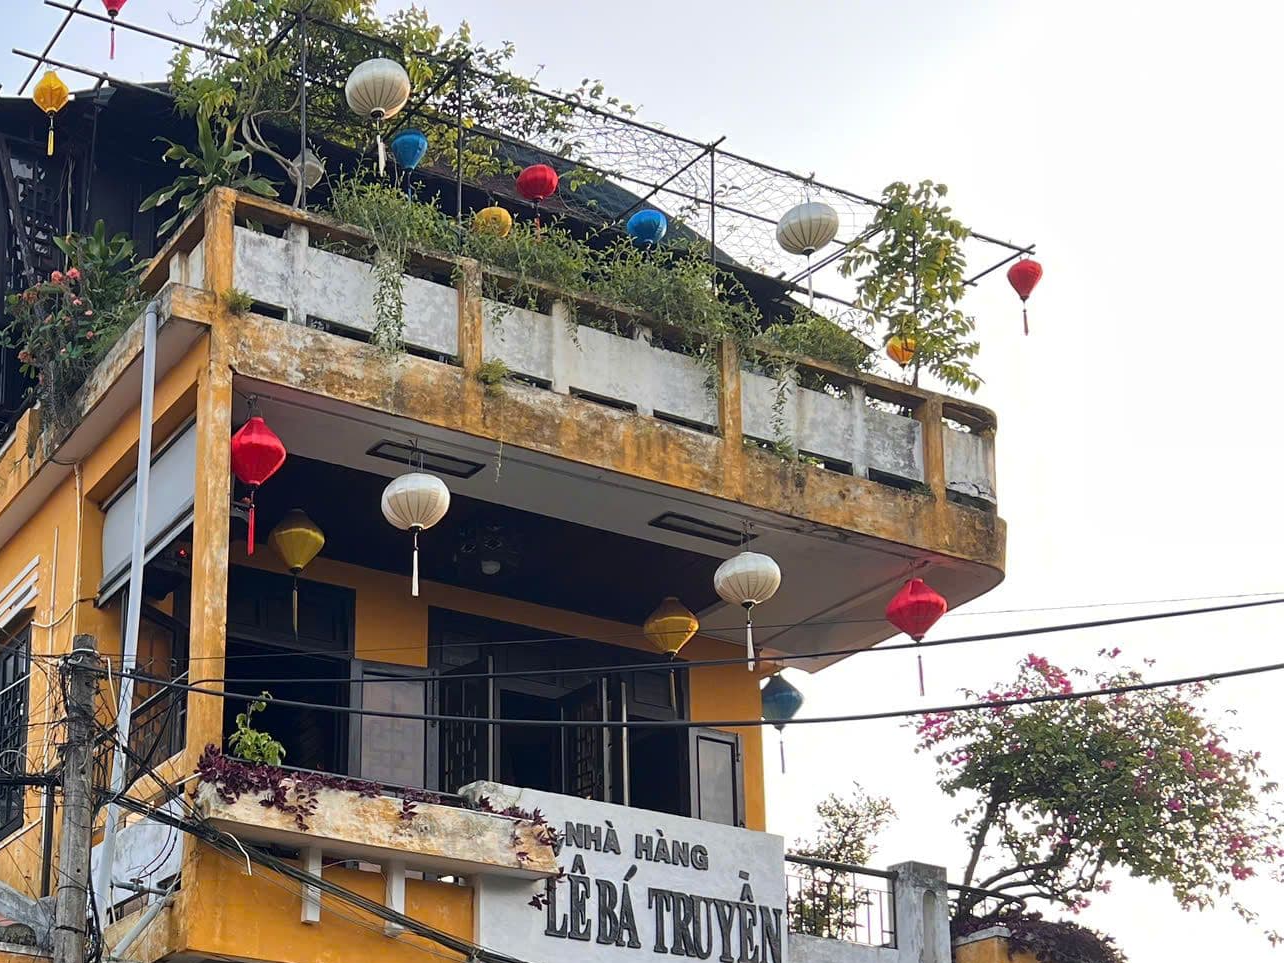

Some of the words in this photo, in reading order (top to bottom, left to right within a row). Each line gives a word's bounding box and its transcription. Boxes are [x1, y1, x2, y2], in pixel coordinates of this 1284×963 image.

[565, 819, 622, 857] NHÀ
[634, 829, 709, 872] HÀNG
[544, 853, 593, 941] LÊ
[595, 864, 642, 949] BÁ
